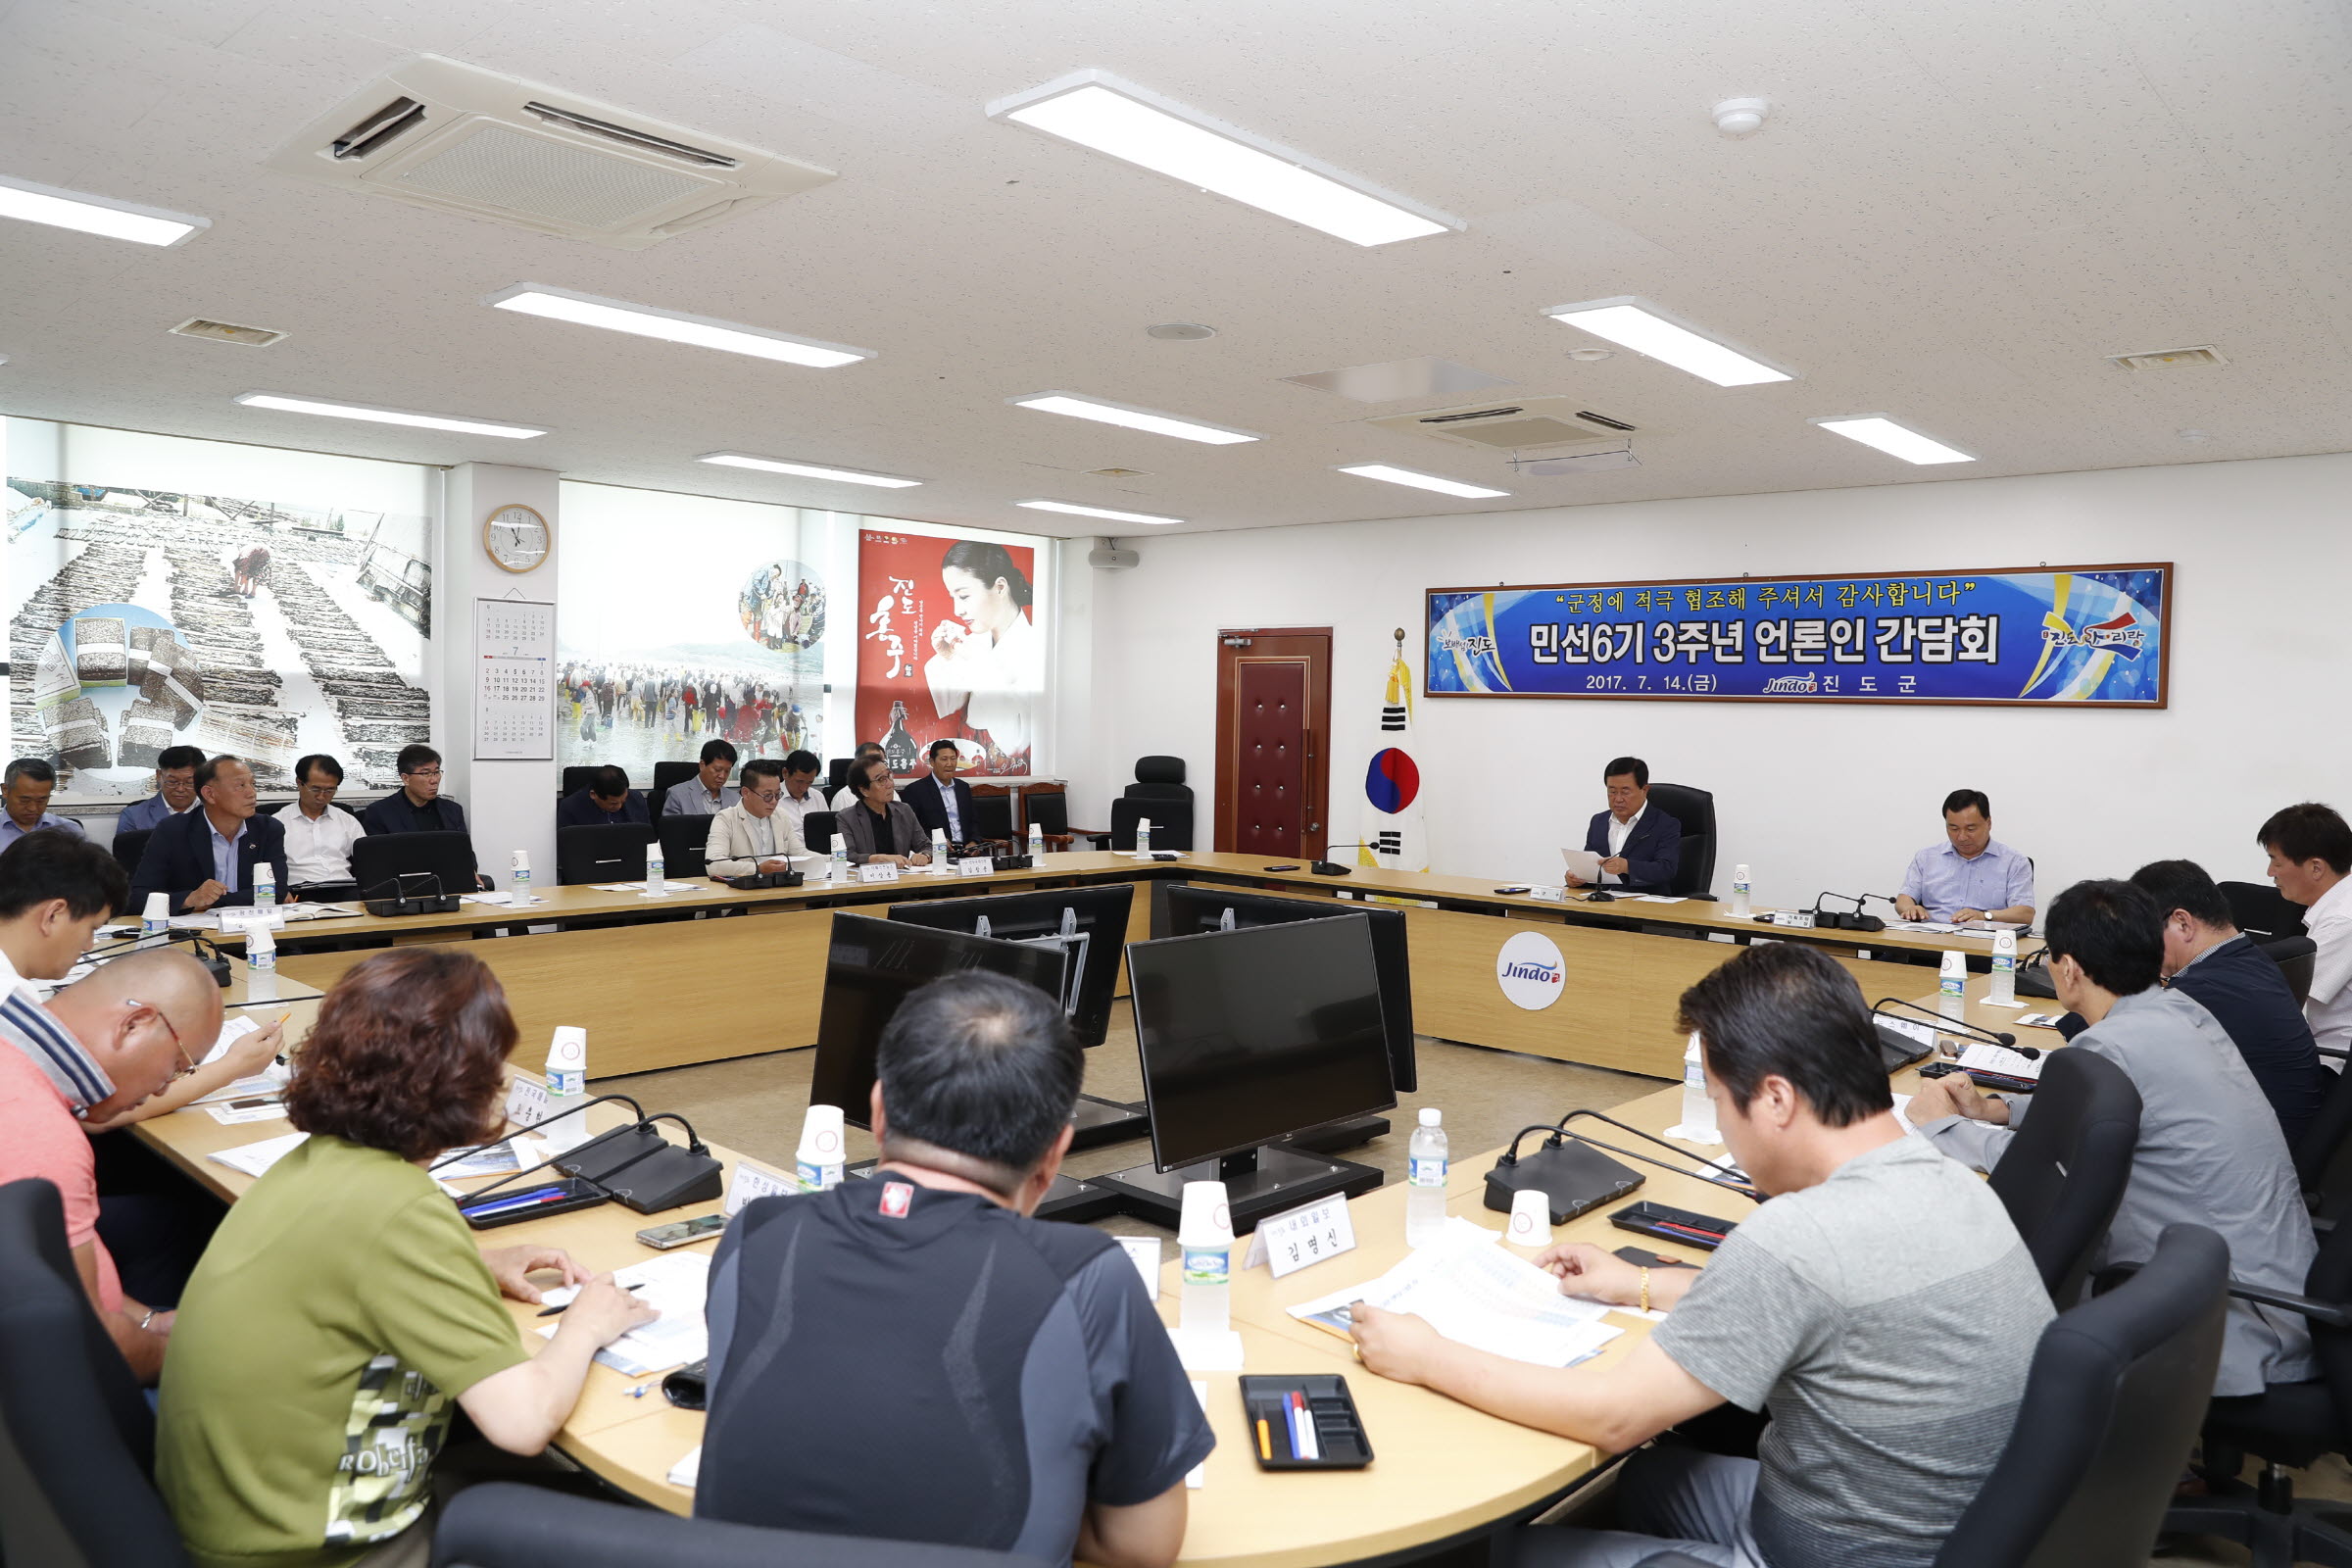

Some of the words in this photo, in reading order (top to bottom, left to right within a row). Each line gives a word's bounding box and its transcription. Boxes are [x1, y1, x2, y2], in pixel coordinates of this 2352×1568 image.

[1635, 590, 1675, 612] 적극
[1685, 587, 1745, 612] 협조해
[1757, 585, 1824, 611] 주셔서
[1530, 620, 1645, 664] 민선6기
[1652, 619, 1745, 664] 3주년
[1753, 617, 1866, 663] 언론인
[1874, 613, 1999, 664] 간담회
[1586, 675, 1627, 690] 2017.
[1638, 675, 1651, 690] 7.
[1663, 673, 1717, 692] 14.(금)
[1501, 961, 1550, 982] Jindo
